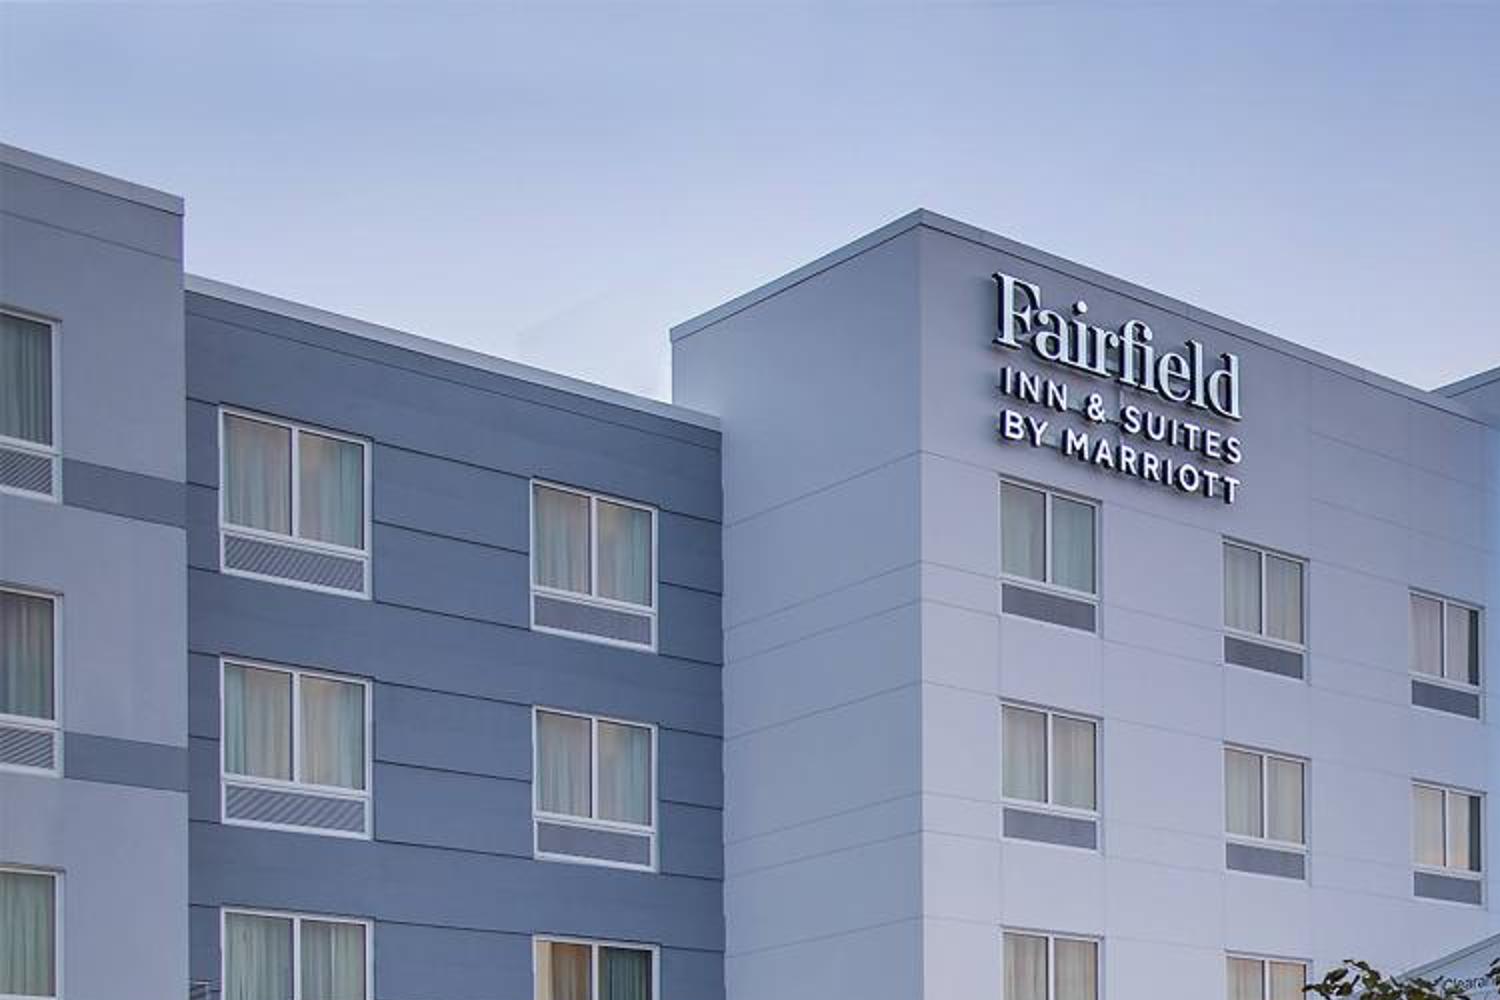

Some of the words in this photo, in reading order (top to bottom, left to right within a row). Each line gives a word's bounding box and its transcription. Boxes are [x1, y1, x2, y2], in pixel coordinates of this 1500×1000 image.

[993, 272, 1241, 419] Fairfield
[1001, 366, 1067, 411] INN
[1085, 393, 1105, 423] &
[1122, 405, 1241, 464] SUITES
[1002, 409, 1048, 447] BY
[1064, 428, 1241, 504] MARRIOTT
